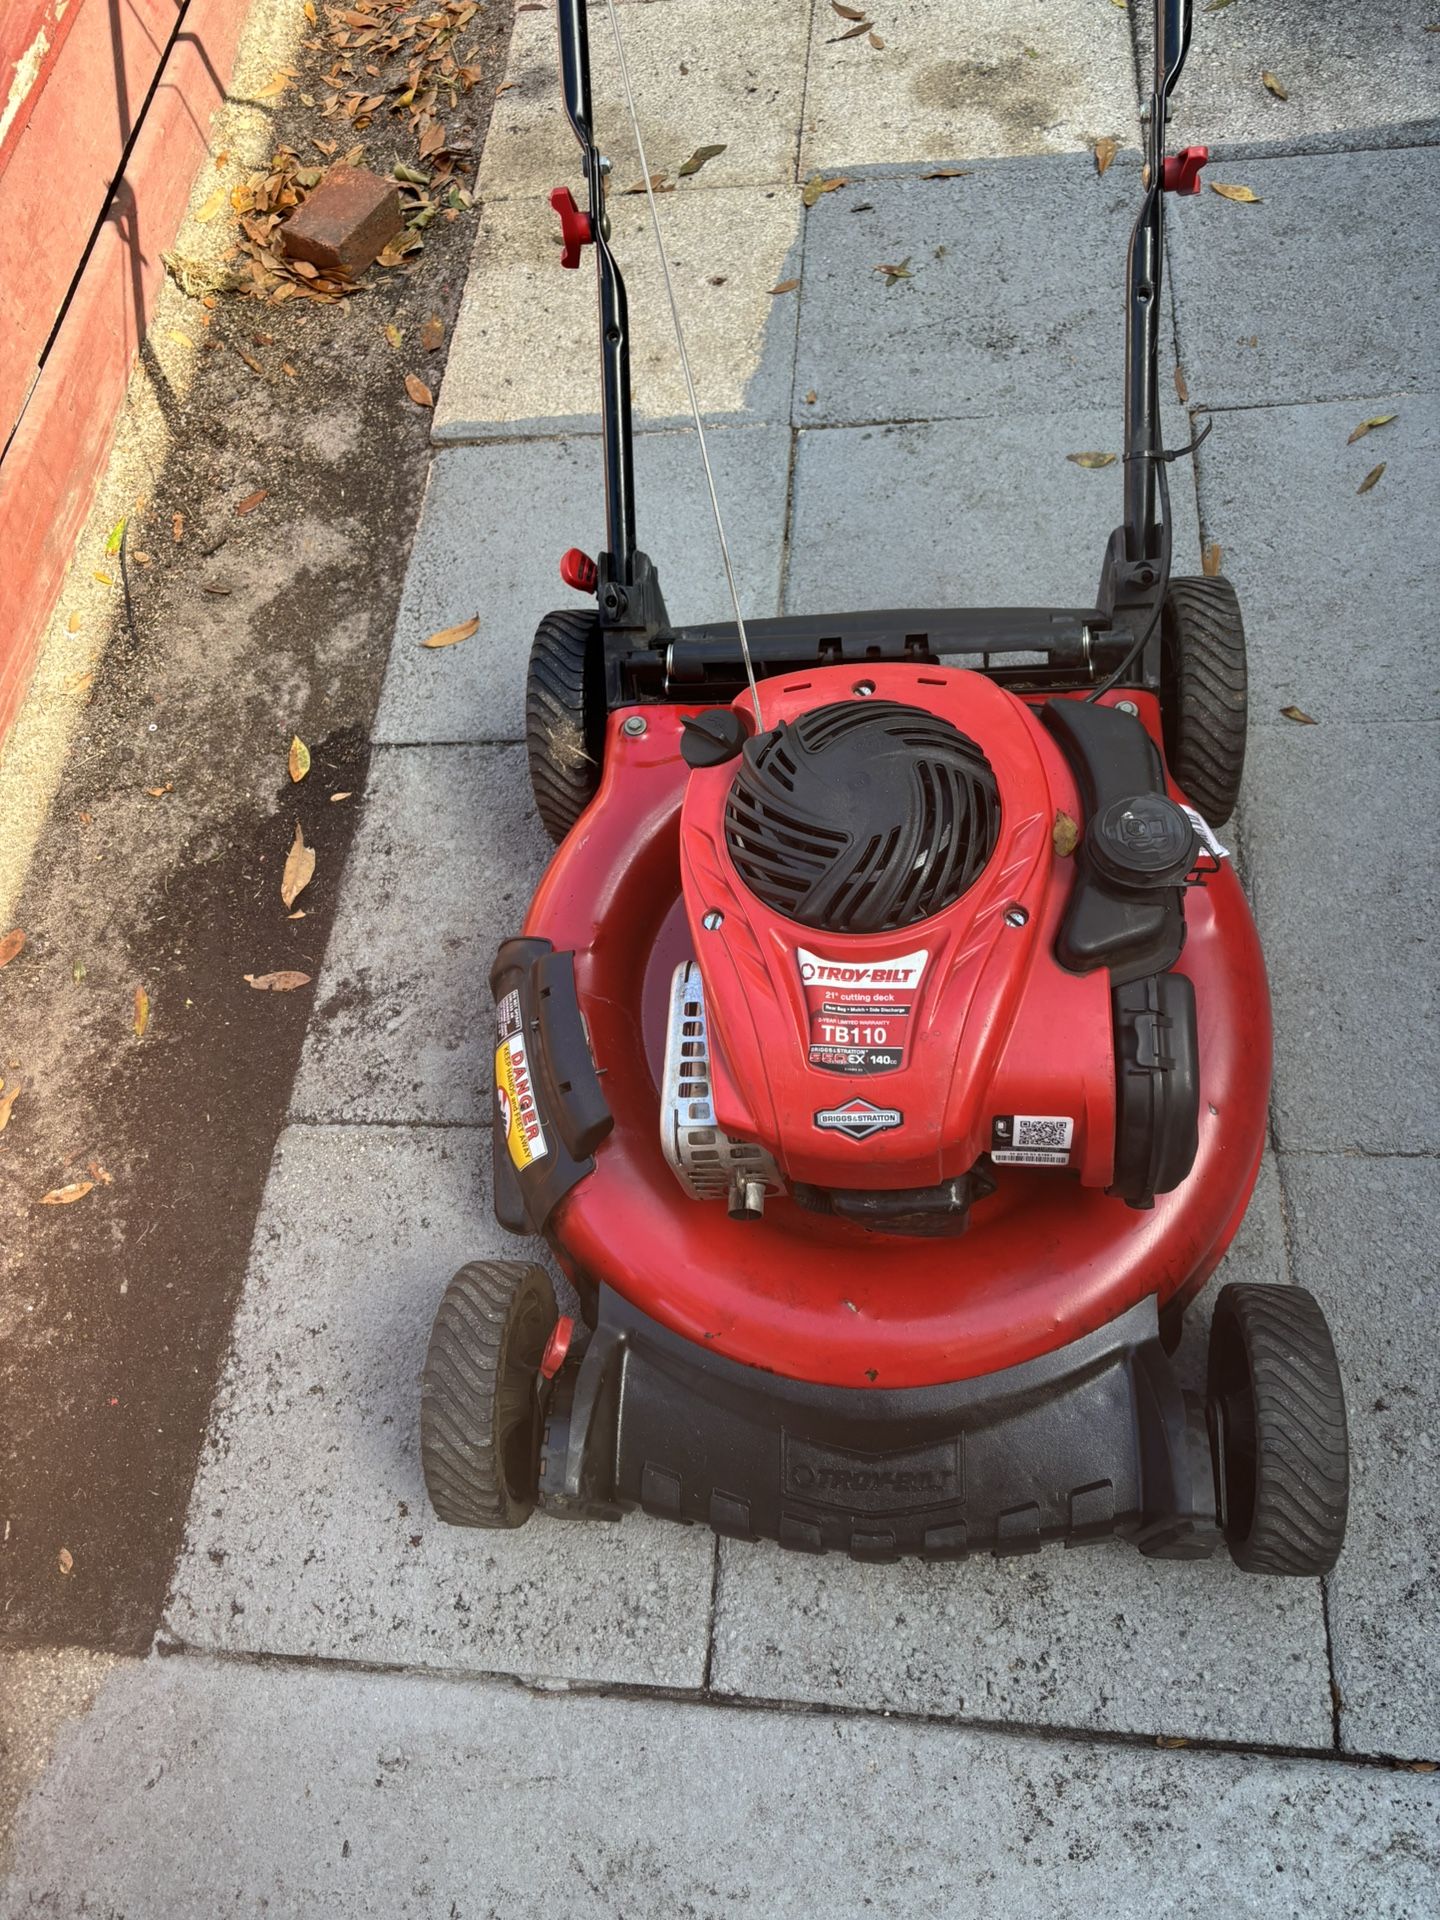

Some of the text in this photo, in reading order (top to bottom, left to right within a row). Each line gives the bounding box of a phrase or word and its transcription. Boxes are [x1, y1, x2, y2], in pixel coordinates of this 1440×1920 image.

[817, 965, 914, 983] TROY-BILT
[840, 993, 870, 1002] cutting
[873, 993, 895, 1001] deck
[821, 1025, 887, 1044] TB110
[503, 1046, 513, 1068] KEEP
[506, 1068, 517, 1097] HANDS
[510, 1051, 540, 1142] DANGER
[511, 1096, 519, 1111] and
[514, 1111, 523, 1134] FEET
[519, 1134, 532, 1159] AWAY
